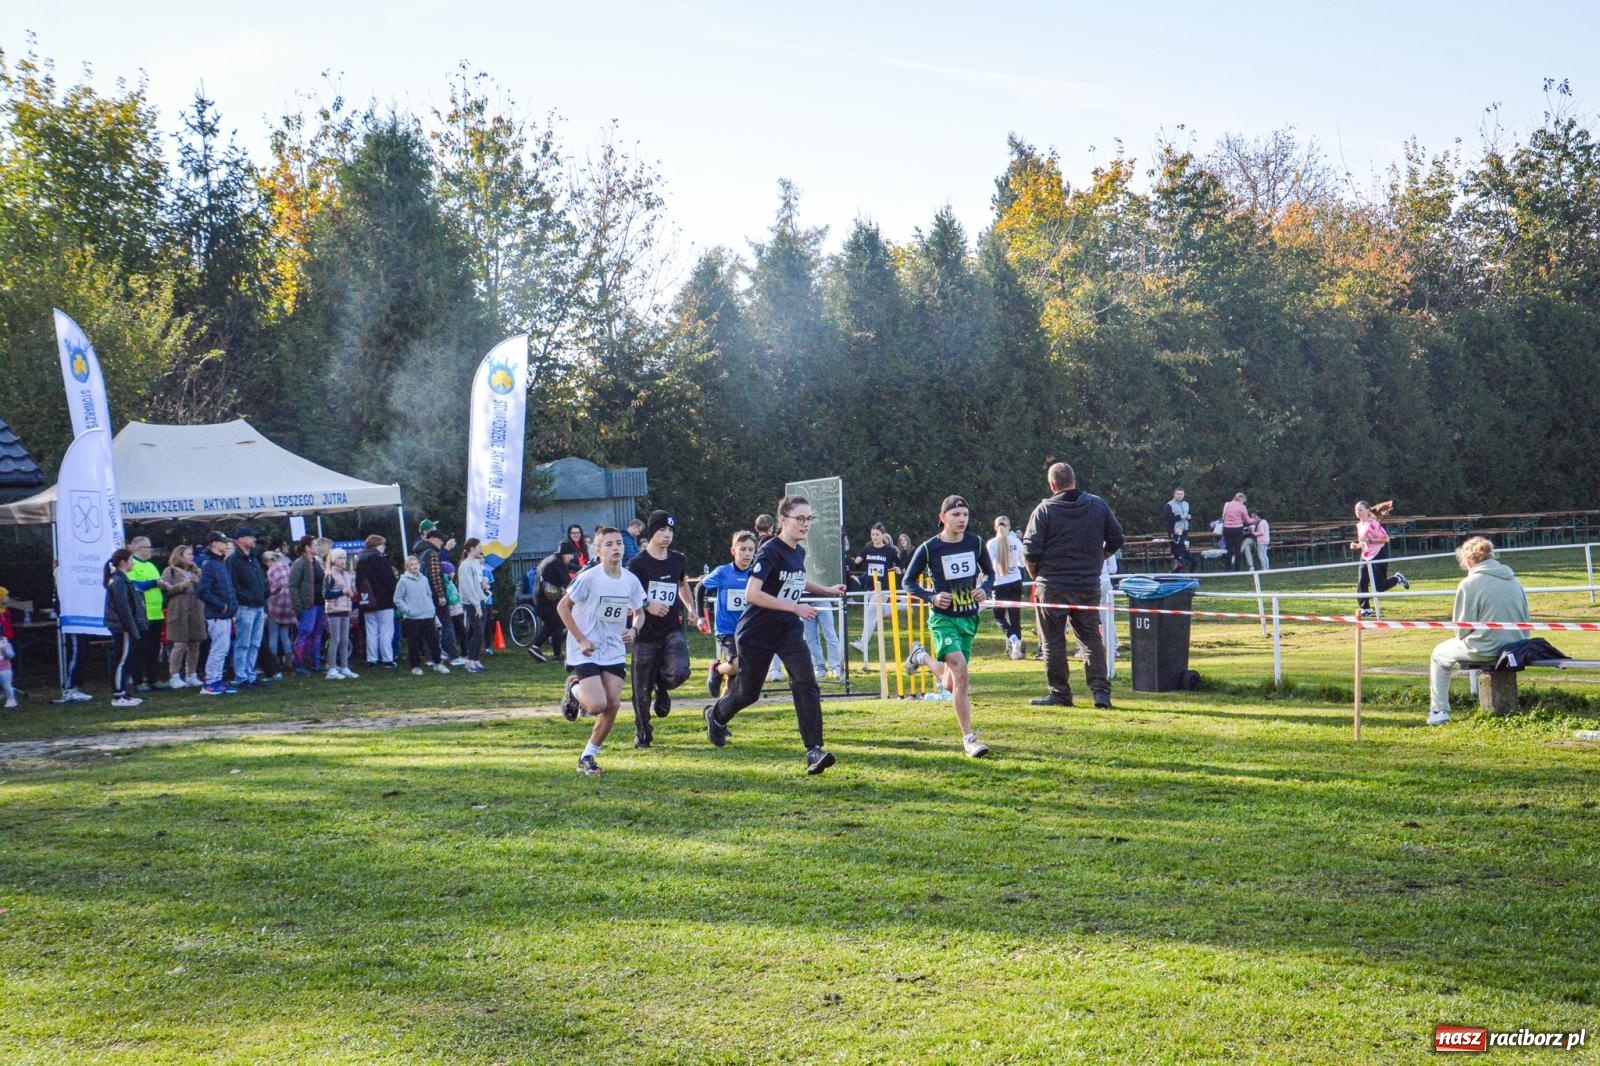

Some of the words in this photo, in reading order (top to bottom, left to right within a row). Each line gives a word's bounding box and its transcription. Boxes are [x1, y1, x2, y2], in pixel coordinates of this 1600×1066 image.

[81, 389, 99, 429] STOWARZYS
[204, 497, 242, 511] AKTYWNI
[248, 496, 266, 509] DLA
[272, 494, 315, 508] LEPSZEGO
[322, 492, 348, 505] JUTRA
[950, 561, 970, 575] 95
[650, 589, 675, 602] 130
[783, 587, 801, 601] 10
[604, 606, 622, 618] 86
[1136, 617, 1150, 630] UG
